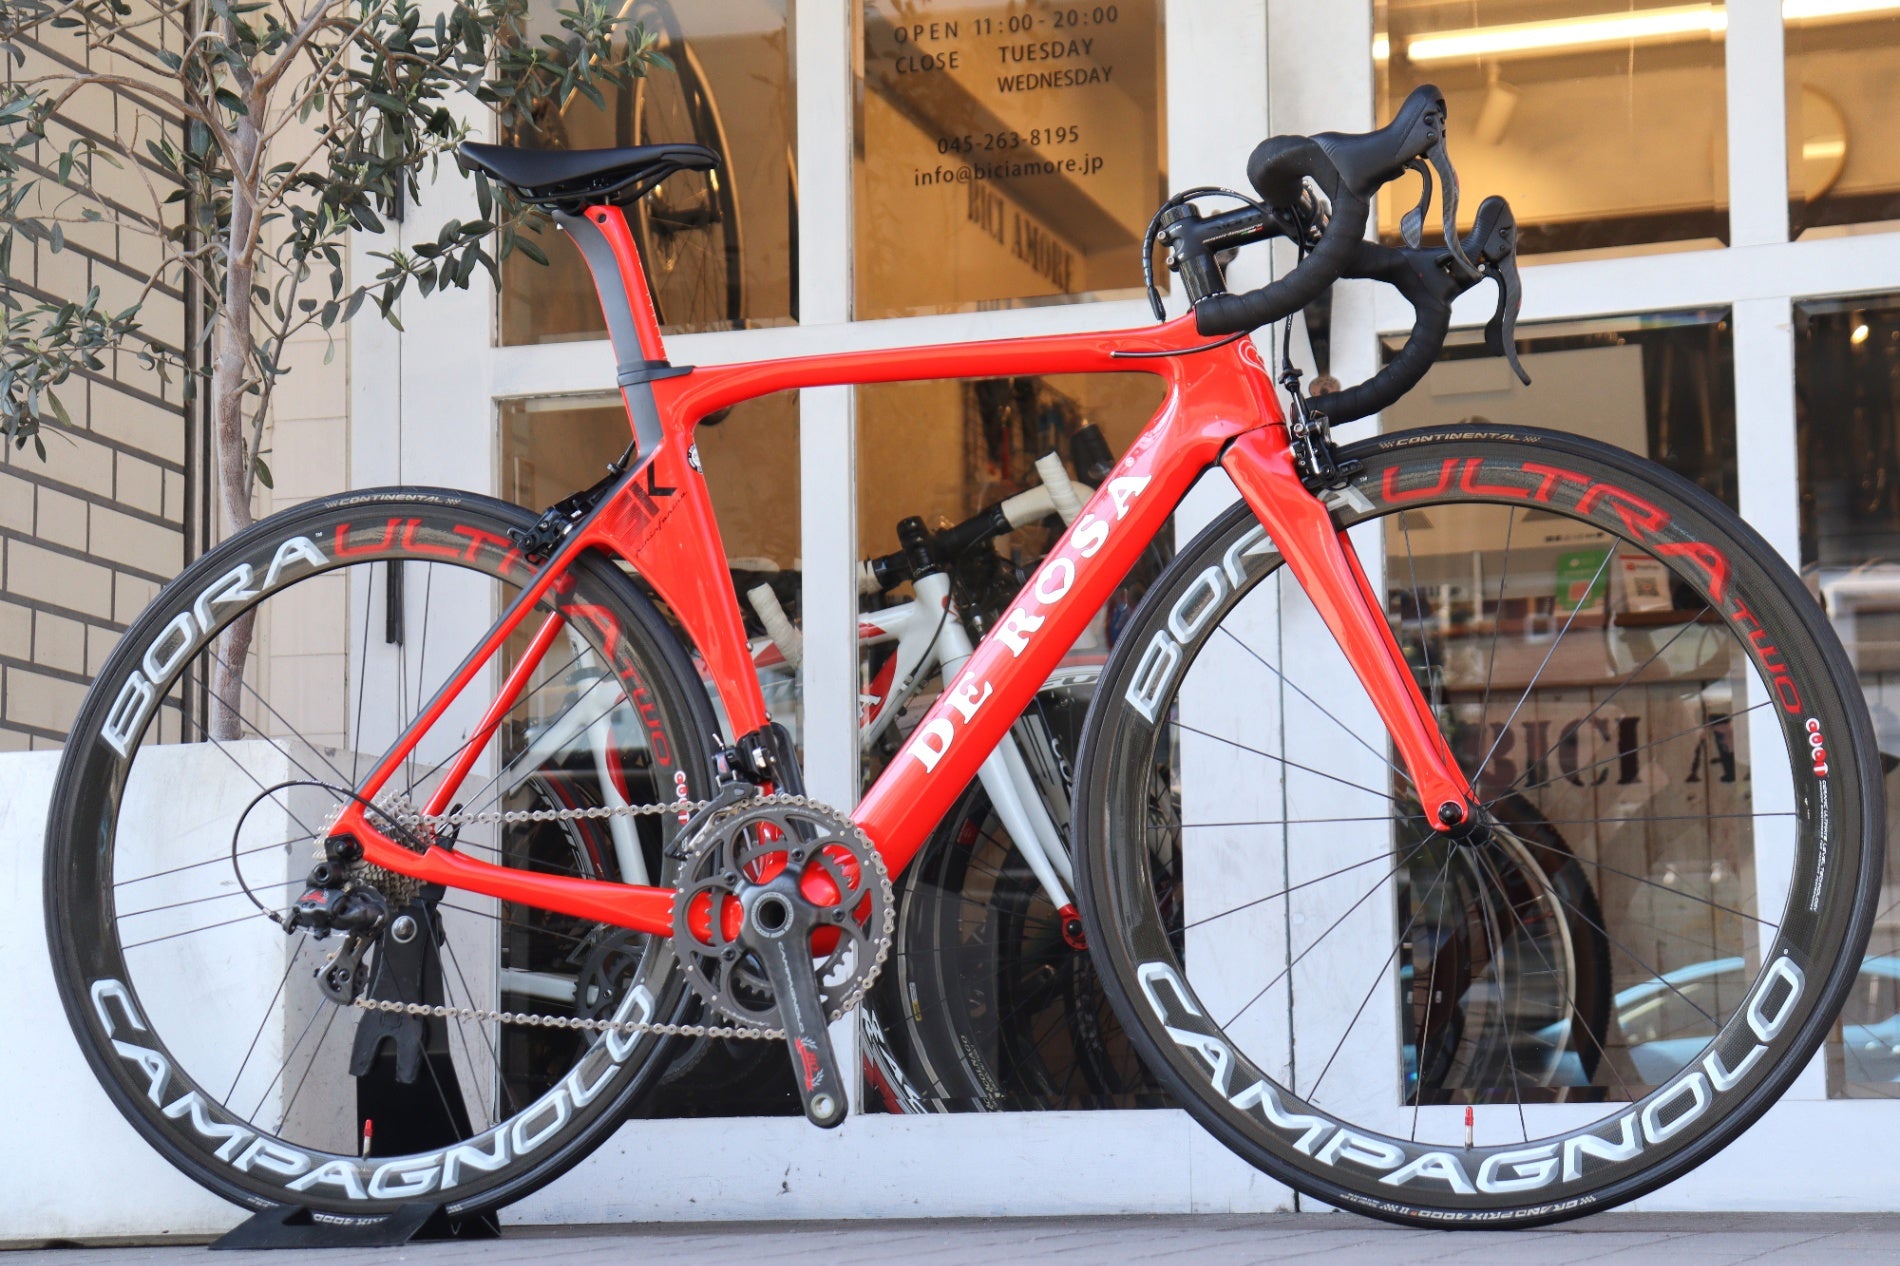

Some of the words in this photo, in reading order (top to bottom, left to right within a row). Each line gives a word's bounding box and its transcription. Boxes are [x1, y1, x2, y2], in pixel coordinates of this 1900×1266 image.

[894, 21, 959, 44] OPEN
[895, 51, 959, 74] CLOSE
[998, 38, 1094, 63] TUESDAY
[997, 66, 1113, 93] WEDNESDAY
[937, 125, 1080, 154] 045-263-8195
[914, 153, 1104, 187] info@biciamore.jp
[1395, 432, 1520, 446] CONTINENTAL
[339, 493, 443, 507] CONTINENTAL
[1381, 457, 1732, 603] ULTRA
[907, 671, 994, 774] DE
[993, 474, 1152, 658] ROSA
[101, 535, 331, 760] BORA
[90, 978, 655, 1199] CAMPAGNOLO
[1137, 956, 1807, 1195] CAMPAGNOLO
[1469, 1210, 1515, 1221] PRIX
[1514, 1198, 1579, 1218] GRAND
